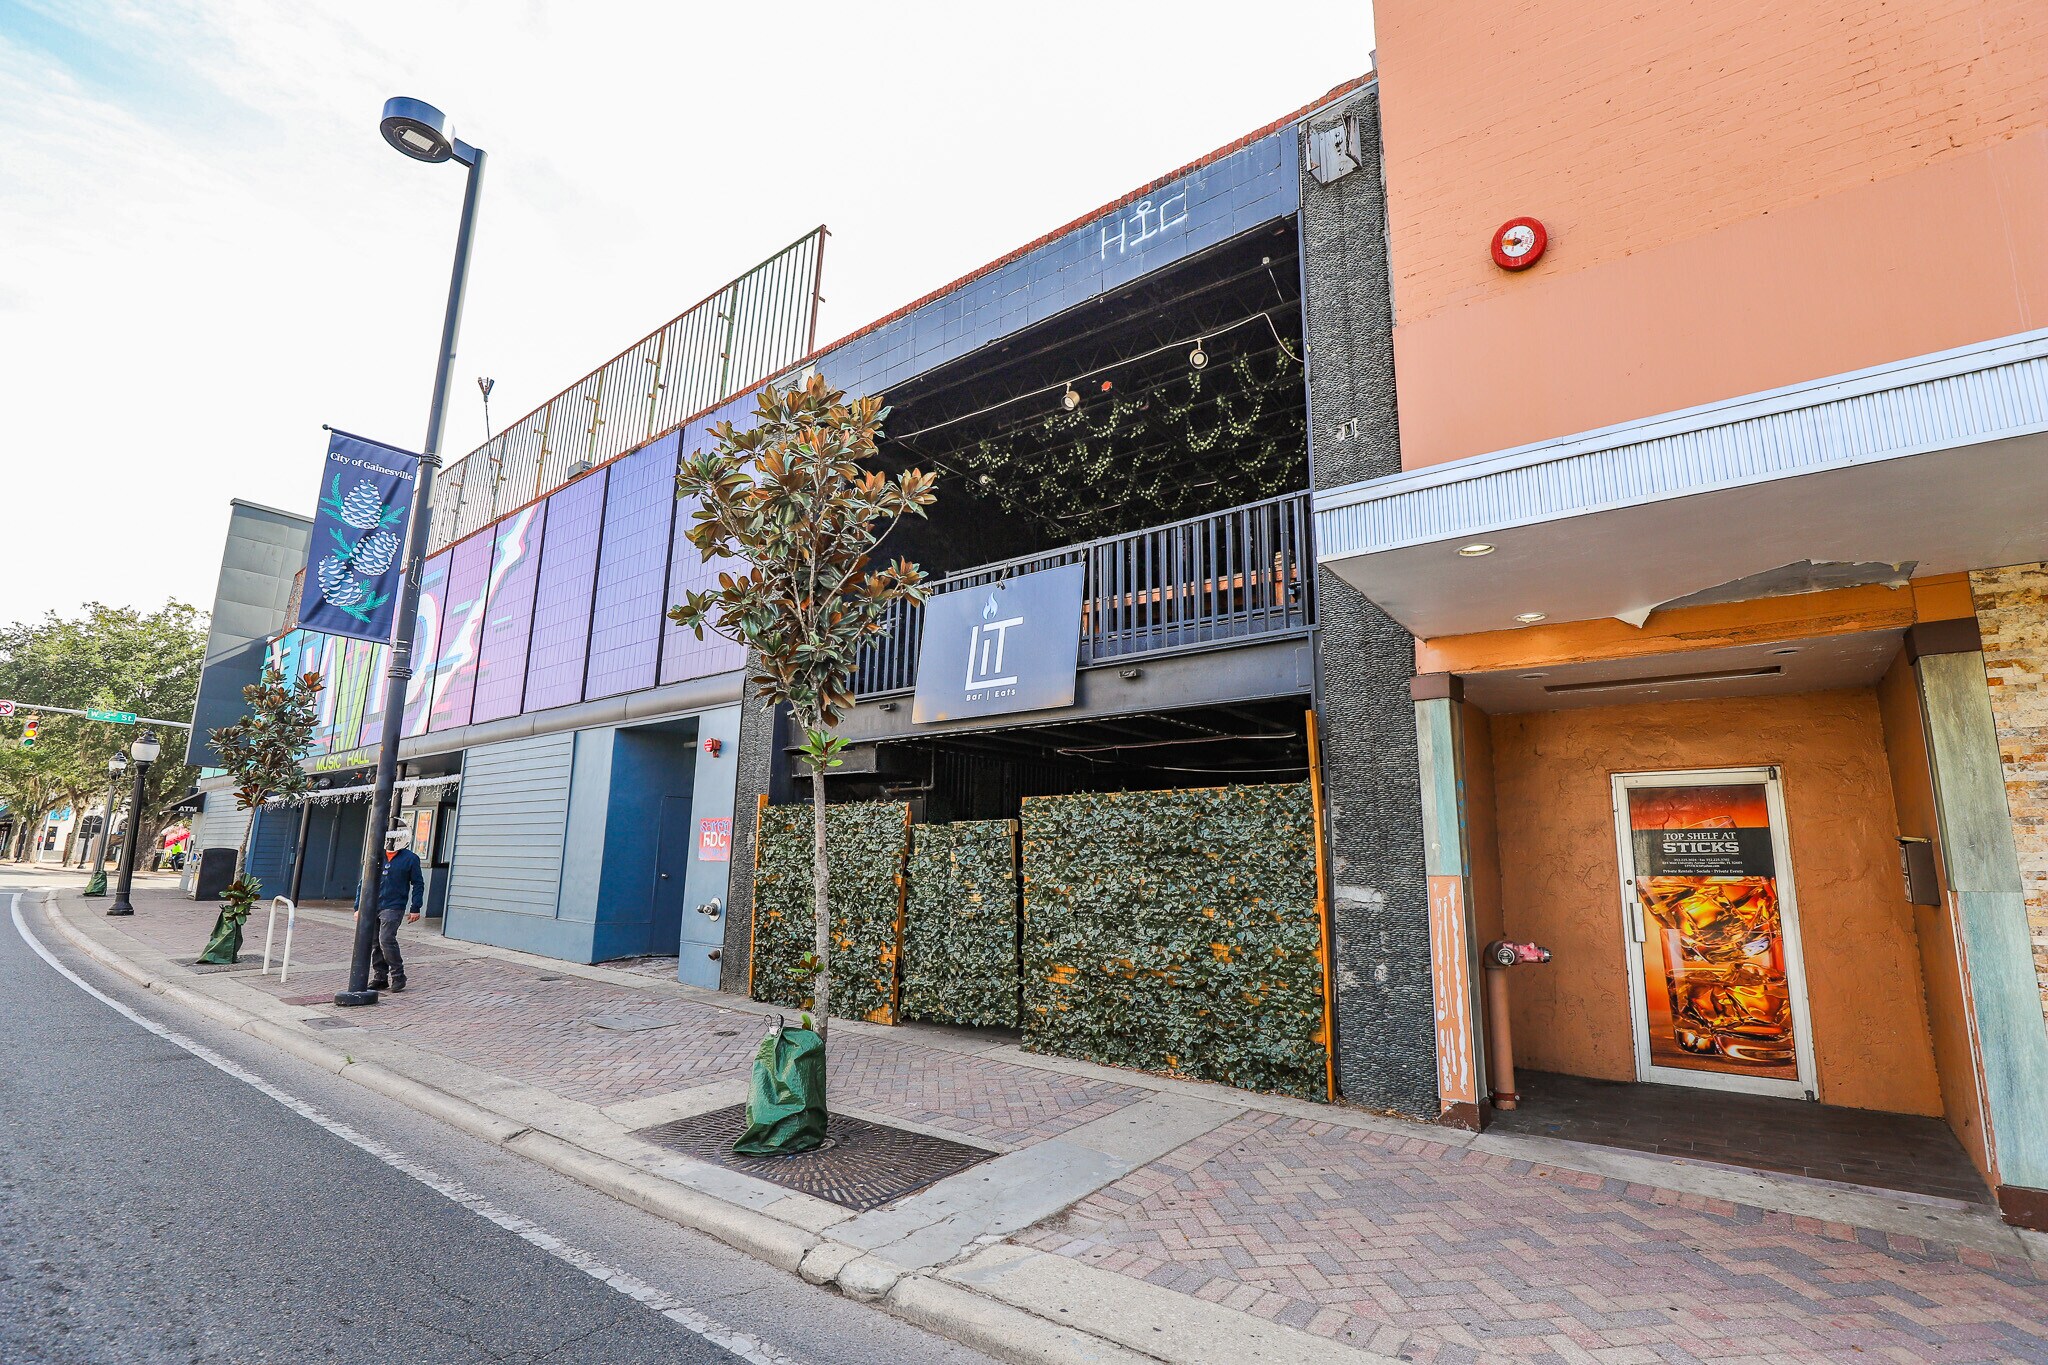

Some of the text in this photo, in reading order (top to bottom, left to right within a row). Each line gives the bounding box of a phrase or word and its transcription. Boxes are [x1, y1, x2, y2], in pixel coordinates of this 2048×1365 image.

[330, 452, 414, 481] City of Gainesville
[966, 688, 1016, 701] Bar Eats
[121, 713, 134, 722] St.
[316, 749, 370, 771] MUSIC HALL
[178, 805, 198, 813] ATM
[1664, 832, 1685, 840] TOP
[1687, 832, 1719, 840] SHELF
[1663, 842, 1739, 853] STICKS
